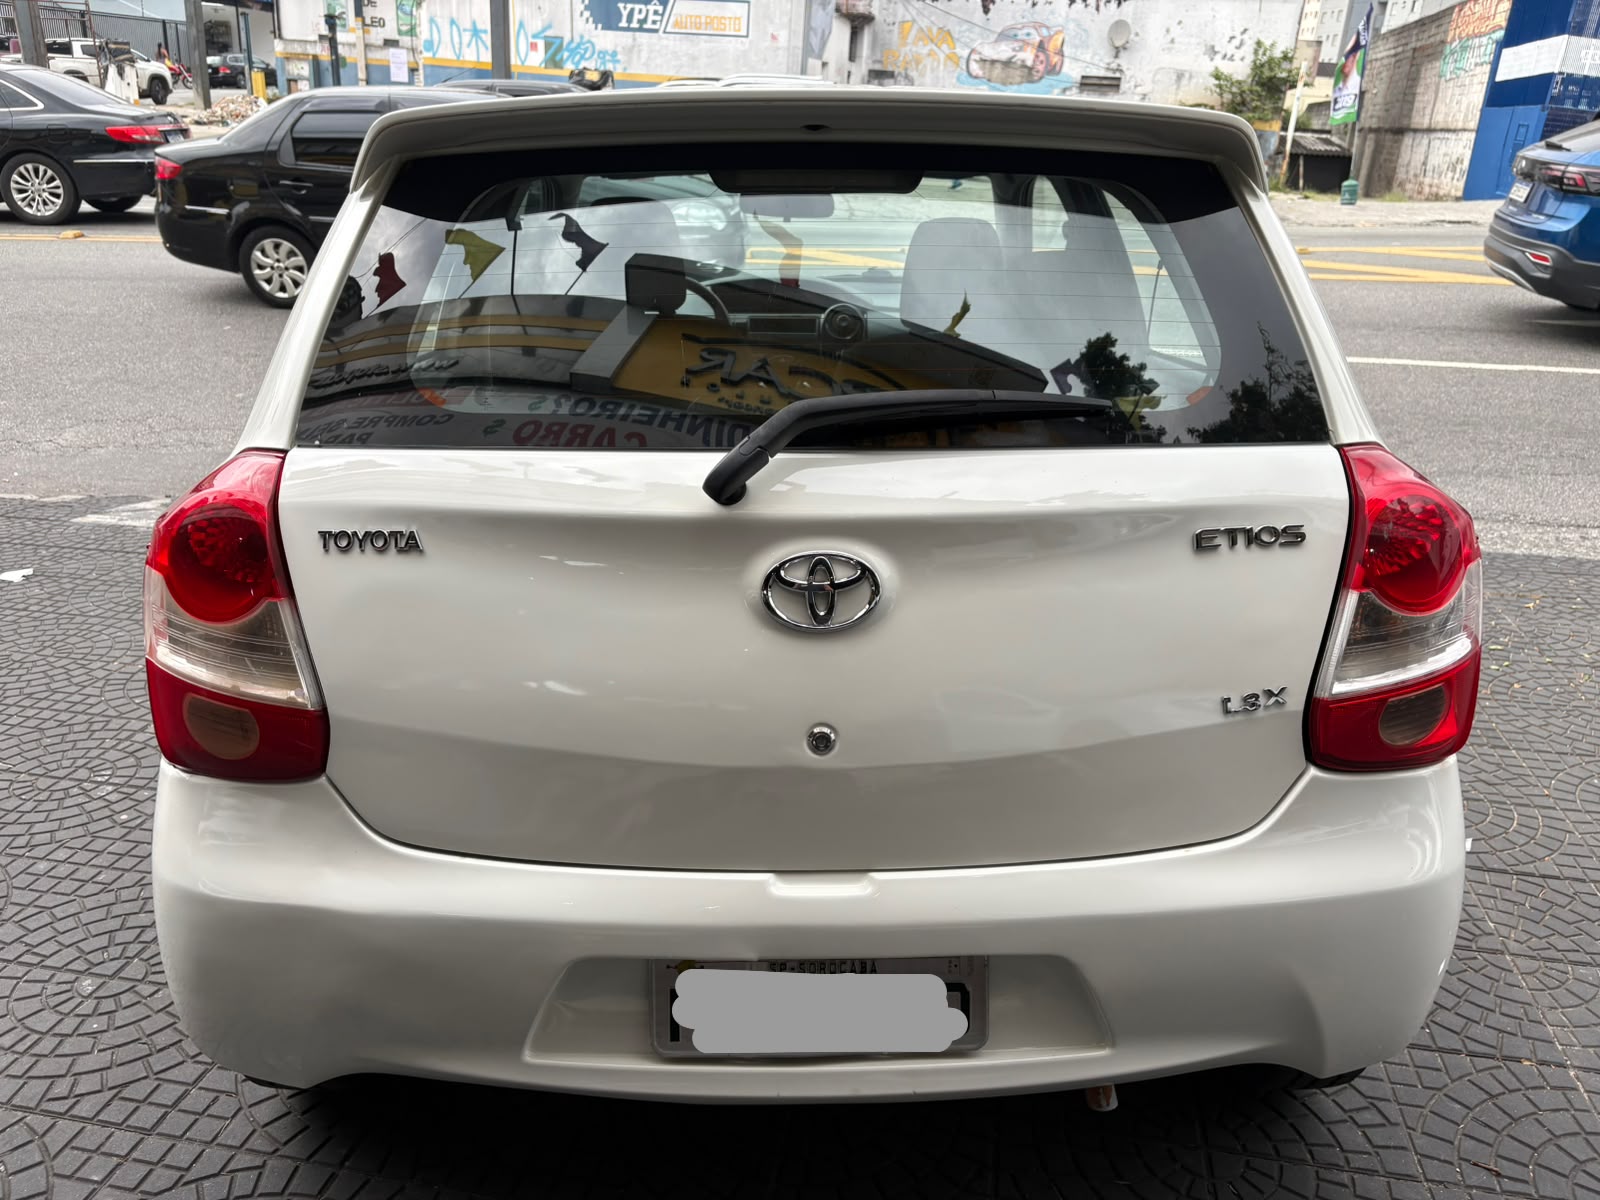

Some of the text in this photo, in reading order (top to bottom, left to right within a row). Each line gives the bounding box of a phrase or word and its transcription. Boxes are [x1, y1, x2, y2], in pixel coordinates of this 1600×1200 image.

[617, 0, 663, 29] YPÊ
[673, 14, 742, 32] AUTO POSTO
[317, 529, 424, 552] TOYOTA
[1192, 525, 1306, 550] ETIOS
